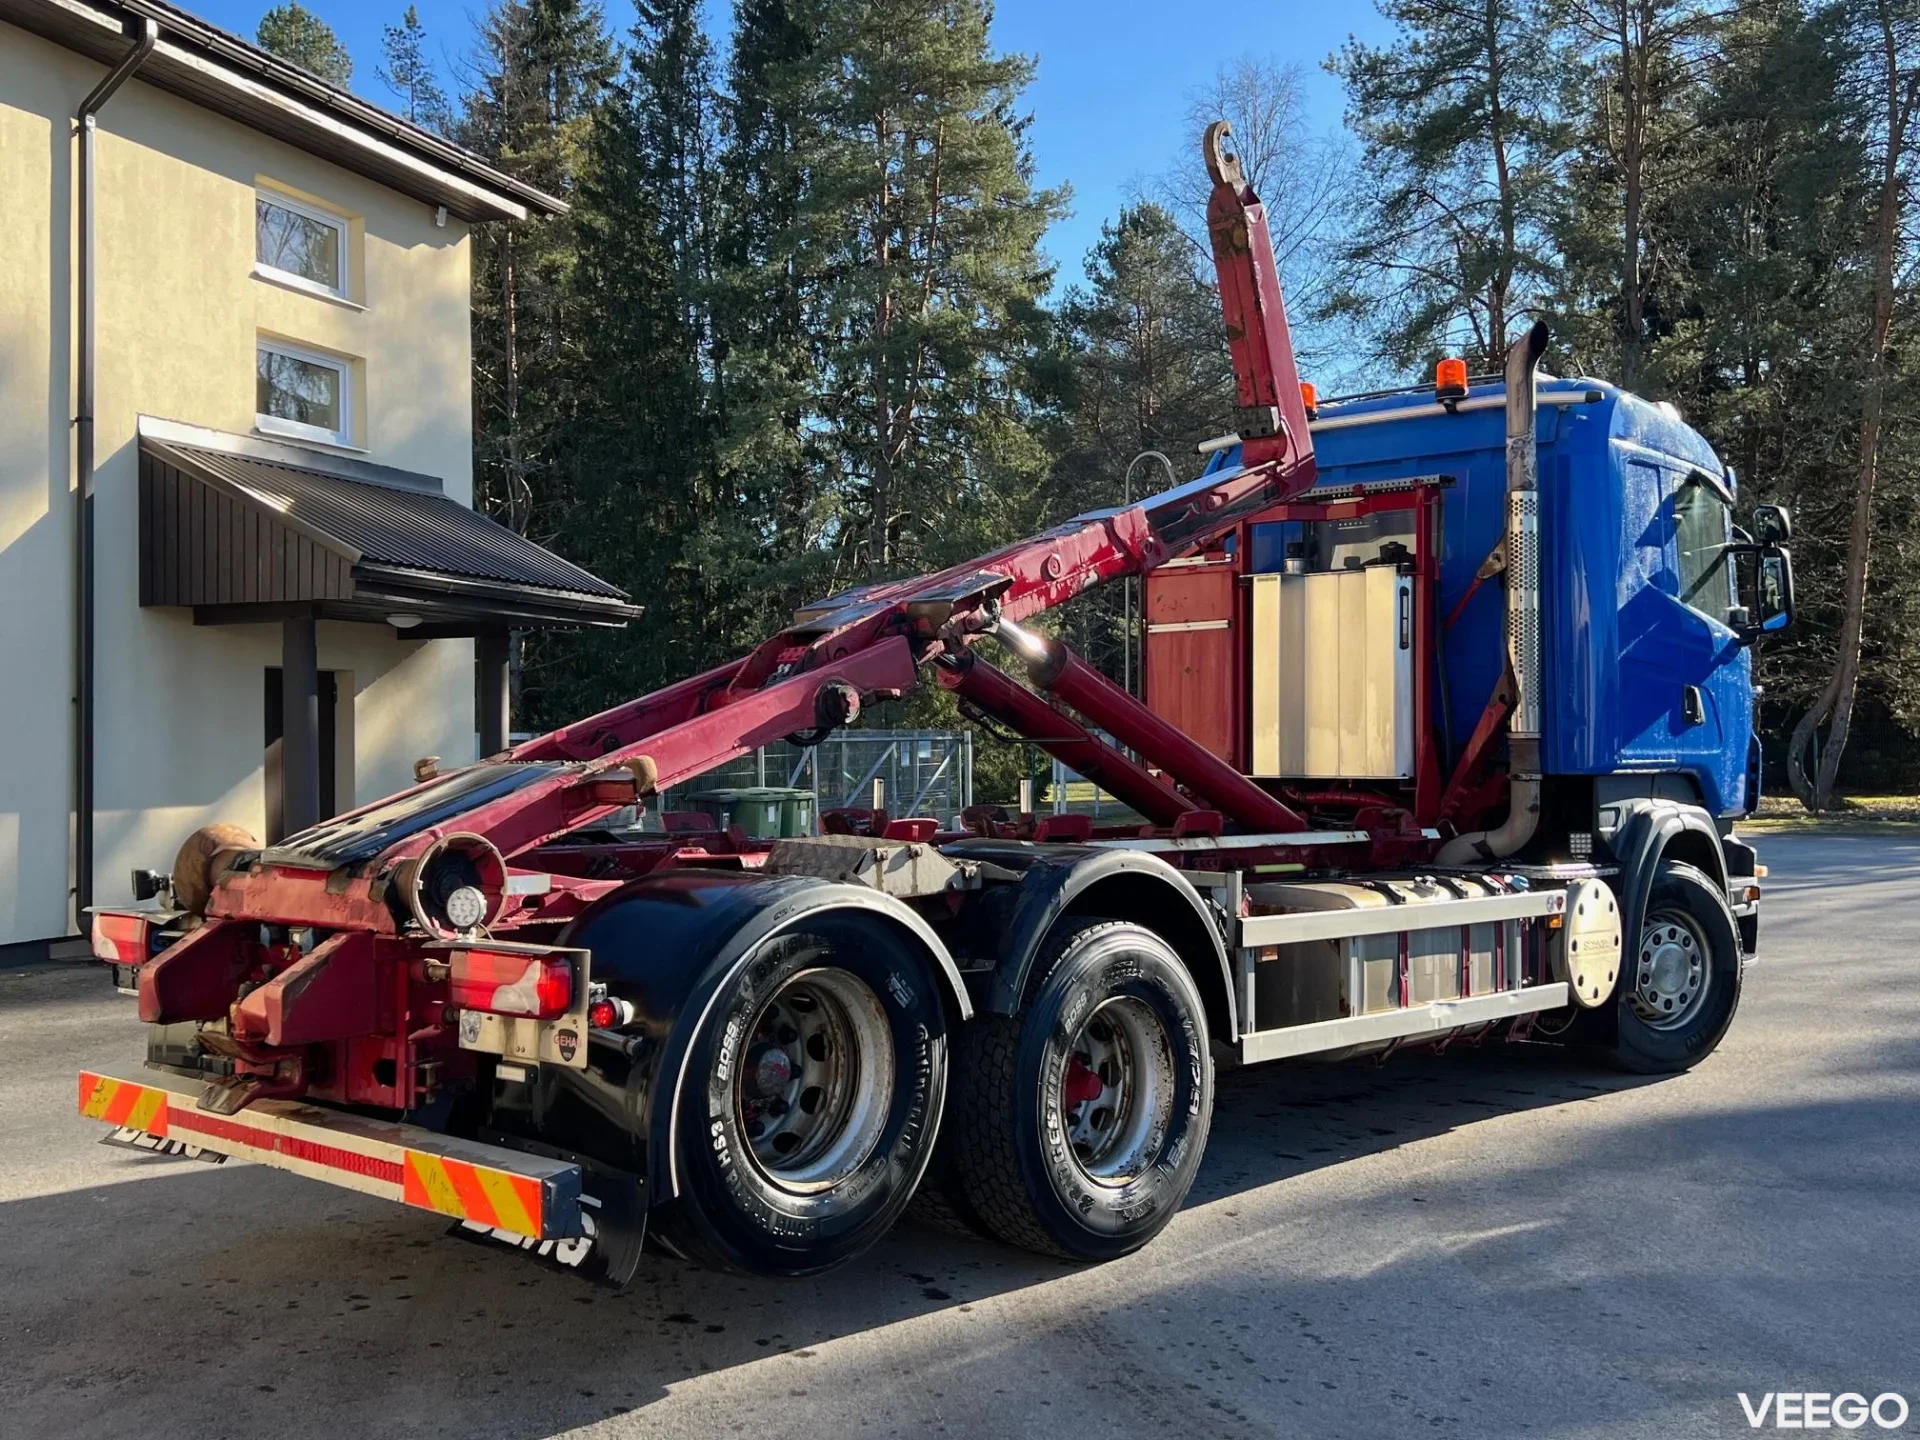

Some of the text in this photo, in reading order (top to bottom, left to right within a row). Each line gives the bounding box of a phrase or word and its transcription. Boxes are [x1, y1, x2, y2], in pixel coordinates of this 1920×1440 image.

[1064, 991, 1087, 1034] BOSS
[716, 1020, 738, 1082] BOSS
[711, 1119, 732, 1169] HS3
